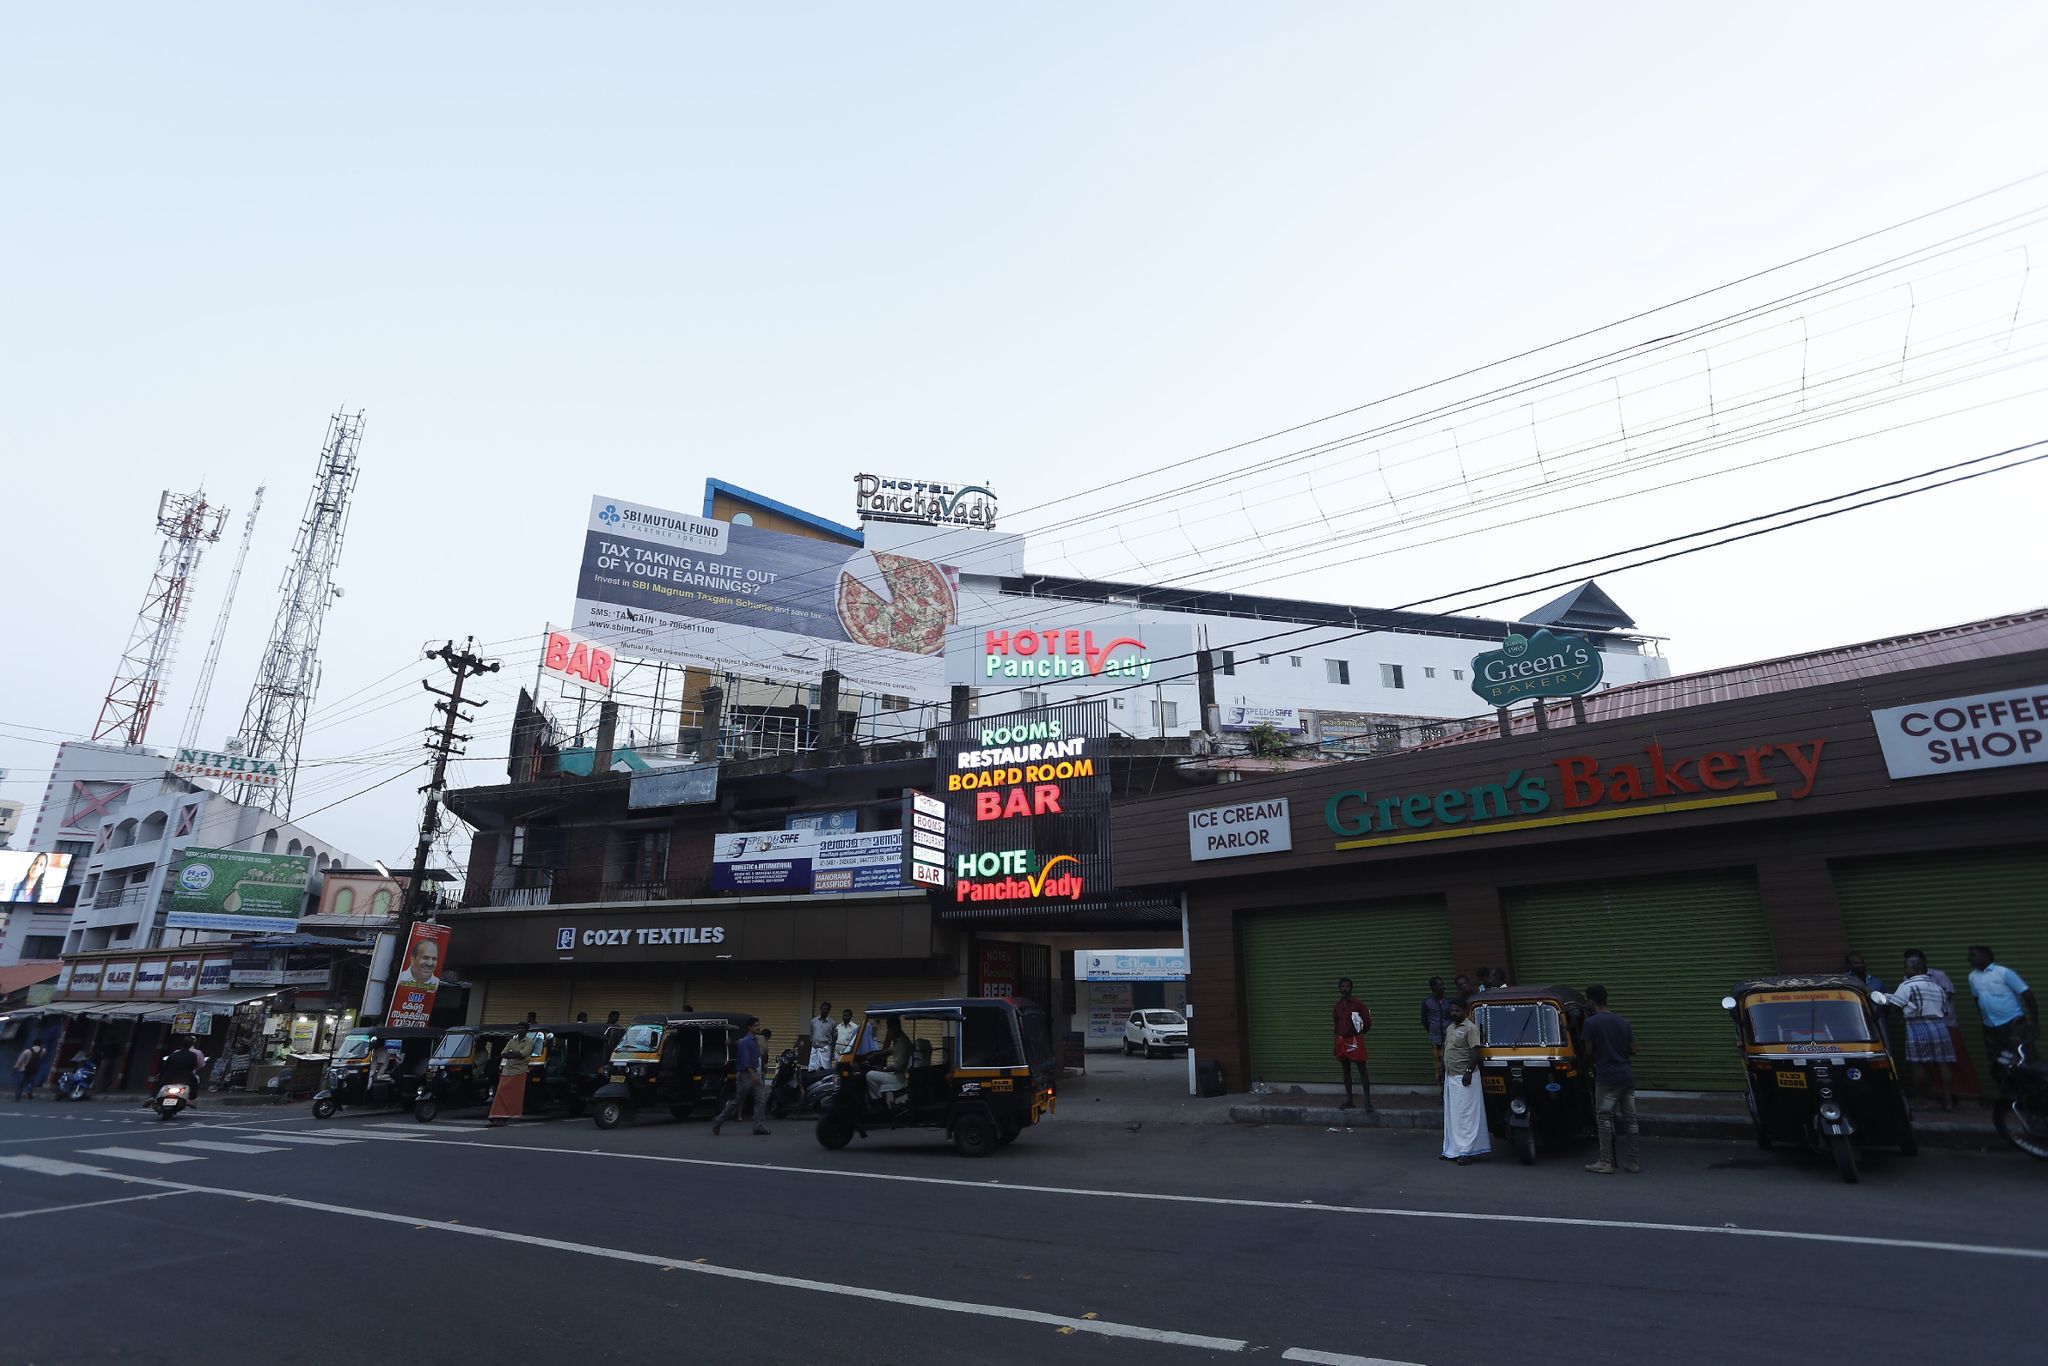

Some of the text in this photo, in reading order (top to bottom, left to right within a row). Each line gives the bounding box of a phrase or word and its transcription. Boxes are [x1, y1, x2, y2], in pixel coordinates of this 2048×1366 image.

[854, 472, 998, 528] PanchaVady
[882, 480, 954, 495] HOTEL
[623, 509, 719, 538] SBI MUTUAL FUND
[631, 525, 673, 538] PARTNER
[677, 534, 694, 543] FOR
[699, 538, 718, 547] LIFE
[597, 556, 761, 596] OF YOUR EARNINGS?
[600, 541, 778, 585] TAX TAKING A BITE OUT
[594, 574, 621, 586] Invest
[622, 578, 630, 587] in
[631, 580, 650, 591] SBI
[652, 584, 694, 599] Magnum
[697, 591, 734, 607] Taxgain
[736, 598, 773, 613] Scheme
[774, 605, 790, 615] and
[790, 608, 809, 617] save
[589, 619, 654, 636] www.sbimf.com
[590, 607, 612, 619] SMS:
[659, 618, 668, 627] to
[985, 629, 1100, 656] HOTEL
[545, 631, 612, 688] BAR
[620, 641, 644, 651] Mutual
[645, 645, 663, 654] Fund
[664, 648, 704, 661] investments
[860, 676, 891, 689] documents
[985, 637, 1152, 681] PanchaVady
[1484, 644, 1589, 683] Green's
[1492, 670, 1584, 697] BAKERY
[1900, 694, 2048, 737] COFFEE
[981, 720, 1062, 747] ROOMS
[1928, 729, 2042, 764] SHOP
[179, 749, 278, 776] NITHYA
[957, 737, 1085, 769] RESTAURANT
[175, 763, 278, 786] HYPERMARKET
[948, 759, 1094, 791] BOARD ROOM
[1324, 737, 1827, 837] Green's Bakery
[976, 784, 1063, 822] BAR
[1192, 801, 1283, 830] ICE CREAM
[917, 816, 942, 831] ROOMS
[914, 829, 944, 848] RESTAURANT
[1207, 830, 1270, 851] PARLOR
[815, 872, 852, 883] MANORAMA
[917, 865, 940, 883] BAR
[956, 855, 1083, 902] PanchaVady
[583, 926, 726, 946] COZY TEXTILES
[983, 983, 1013, 998] BEER
